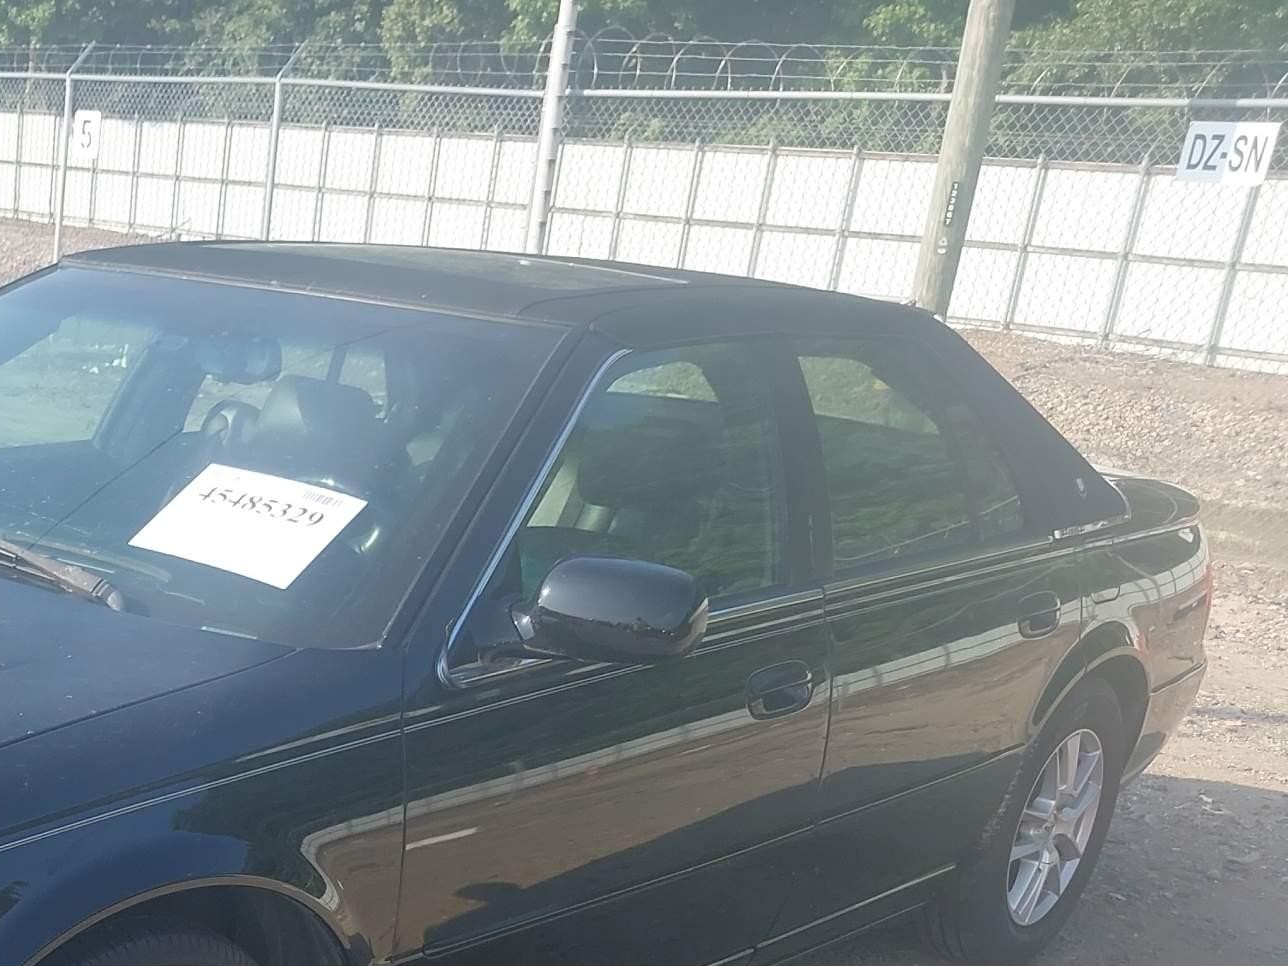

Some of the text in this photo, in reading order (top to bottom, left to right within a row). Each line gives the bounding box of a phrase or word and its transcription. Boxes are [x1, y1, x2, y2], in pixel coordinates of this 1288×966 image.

[81, 119, 92, 149] 5
[1186, 133, 1268, 173] DZ-SN
[199, 487, 324, 526] 45485329
